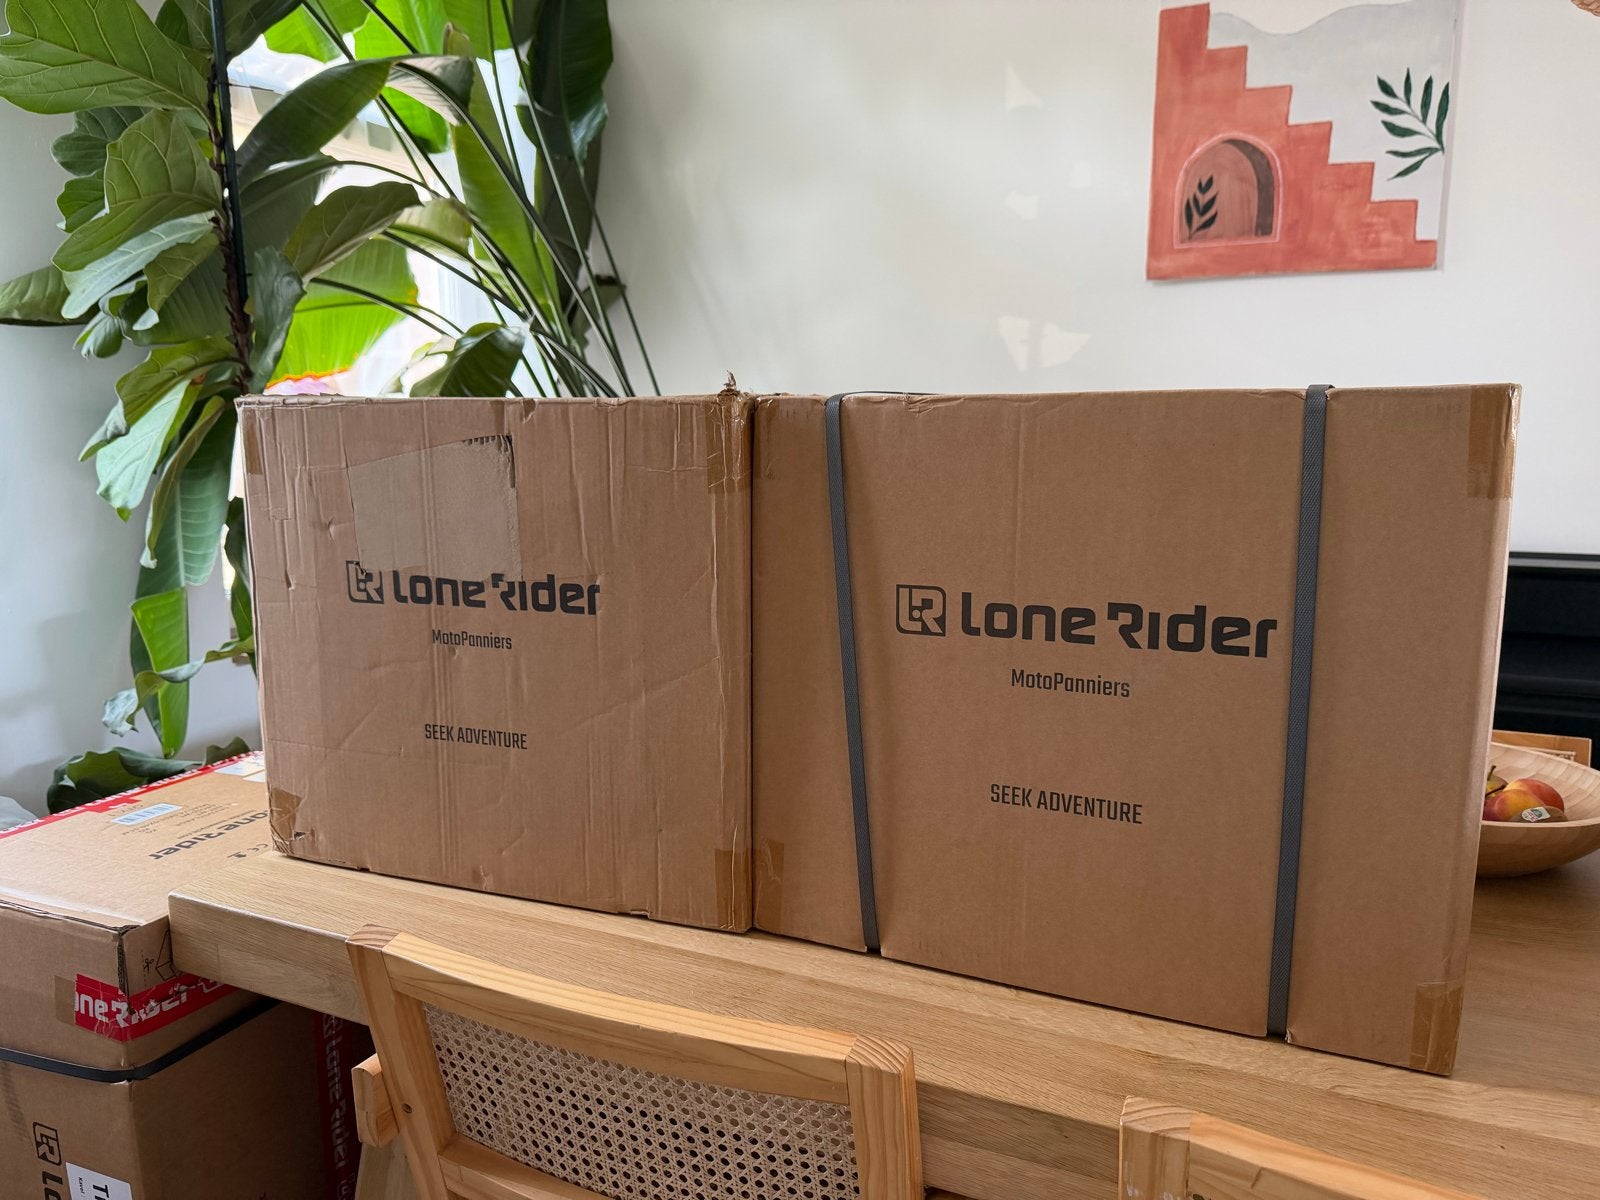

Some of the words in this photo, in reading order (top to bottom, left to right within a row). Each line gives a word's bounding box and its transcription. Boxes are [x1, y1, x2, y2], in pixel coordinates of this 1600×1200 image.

[392, 569, 486, 609] Lone
[491, 573, 600, 616] Rider
[432, 628, 513, 650] MotoPanniers
[961, 592, 1097, 645] Lone
[1107, 602, 1278, 659] Rider
[1011, 668, 1131, 699] MotoPanniers
[424, 723, 455, 743] SEEK
[457, 726, 528, 751] ADVENTURE
[990, 783, 1033, 808] SEEK
[1036, 790, 1143, 825] ADVENTURE
[148, 830, 226, 860] Rider
